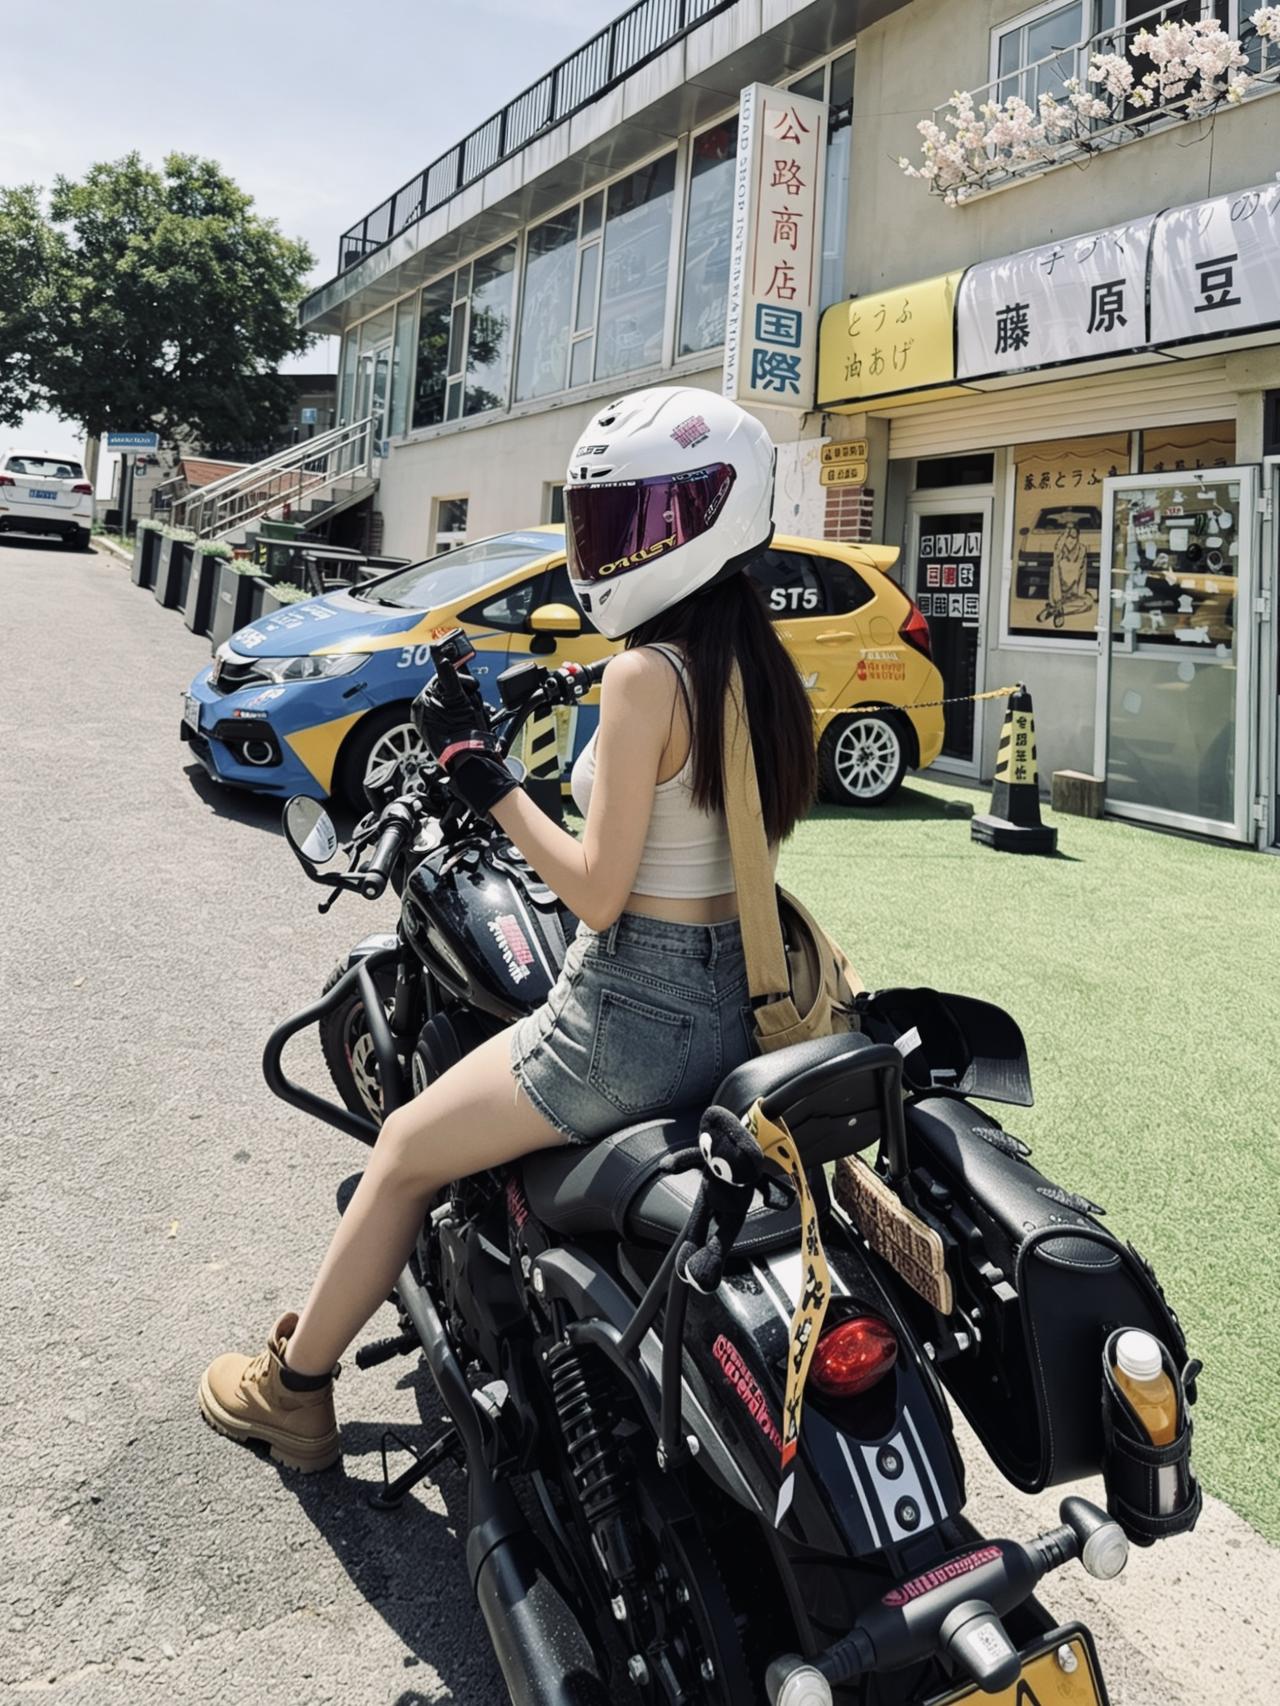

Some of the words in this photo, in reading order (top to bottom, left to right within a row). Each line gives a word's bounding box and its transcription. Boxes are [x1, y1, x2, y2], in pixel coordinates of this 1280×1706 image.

[847, 299, 912, 337] とうふ
[844, 338, 914, 382] 油あげ
[769, 586, 818, 612] ST5
